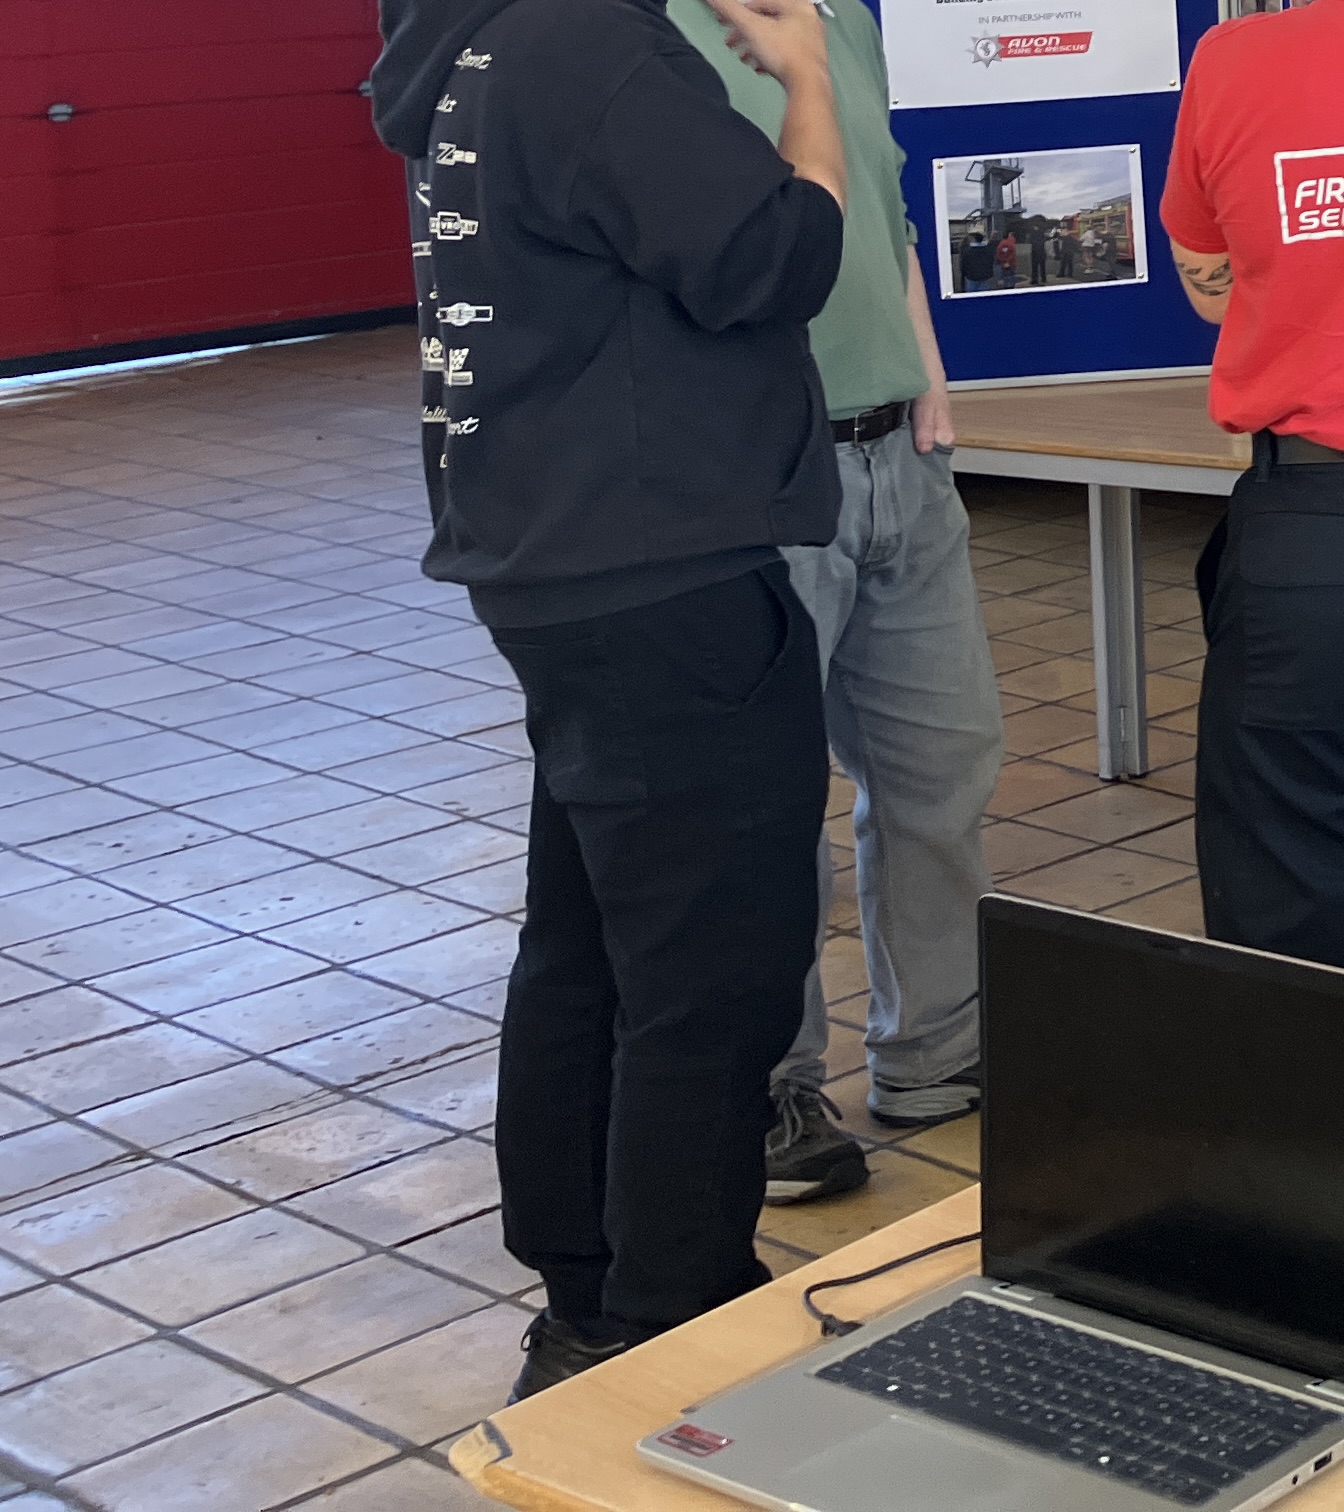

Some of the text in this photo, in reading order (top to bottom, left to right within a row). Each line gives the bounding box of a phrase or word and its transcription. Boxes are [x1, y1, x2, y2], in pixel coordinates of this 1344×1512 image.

[978, 11, 1082, 24] IN PARTNERSHIP WITH
[1008, 36, 1061, 48] AVON
[1045, 44, 1087, 53] RESCUE
